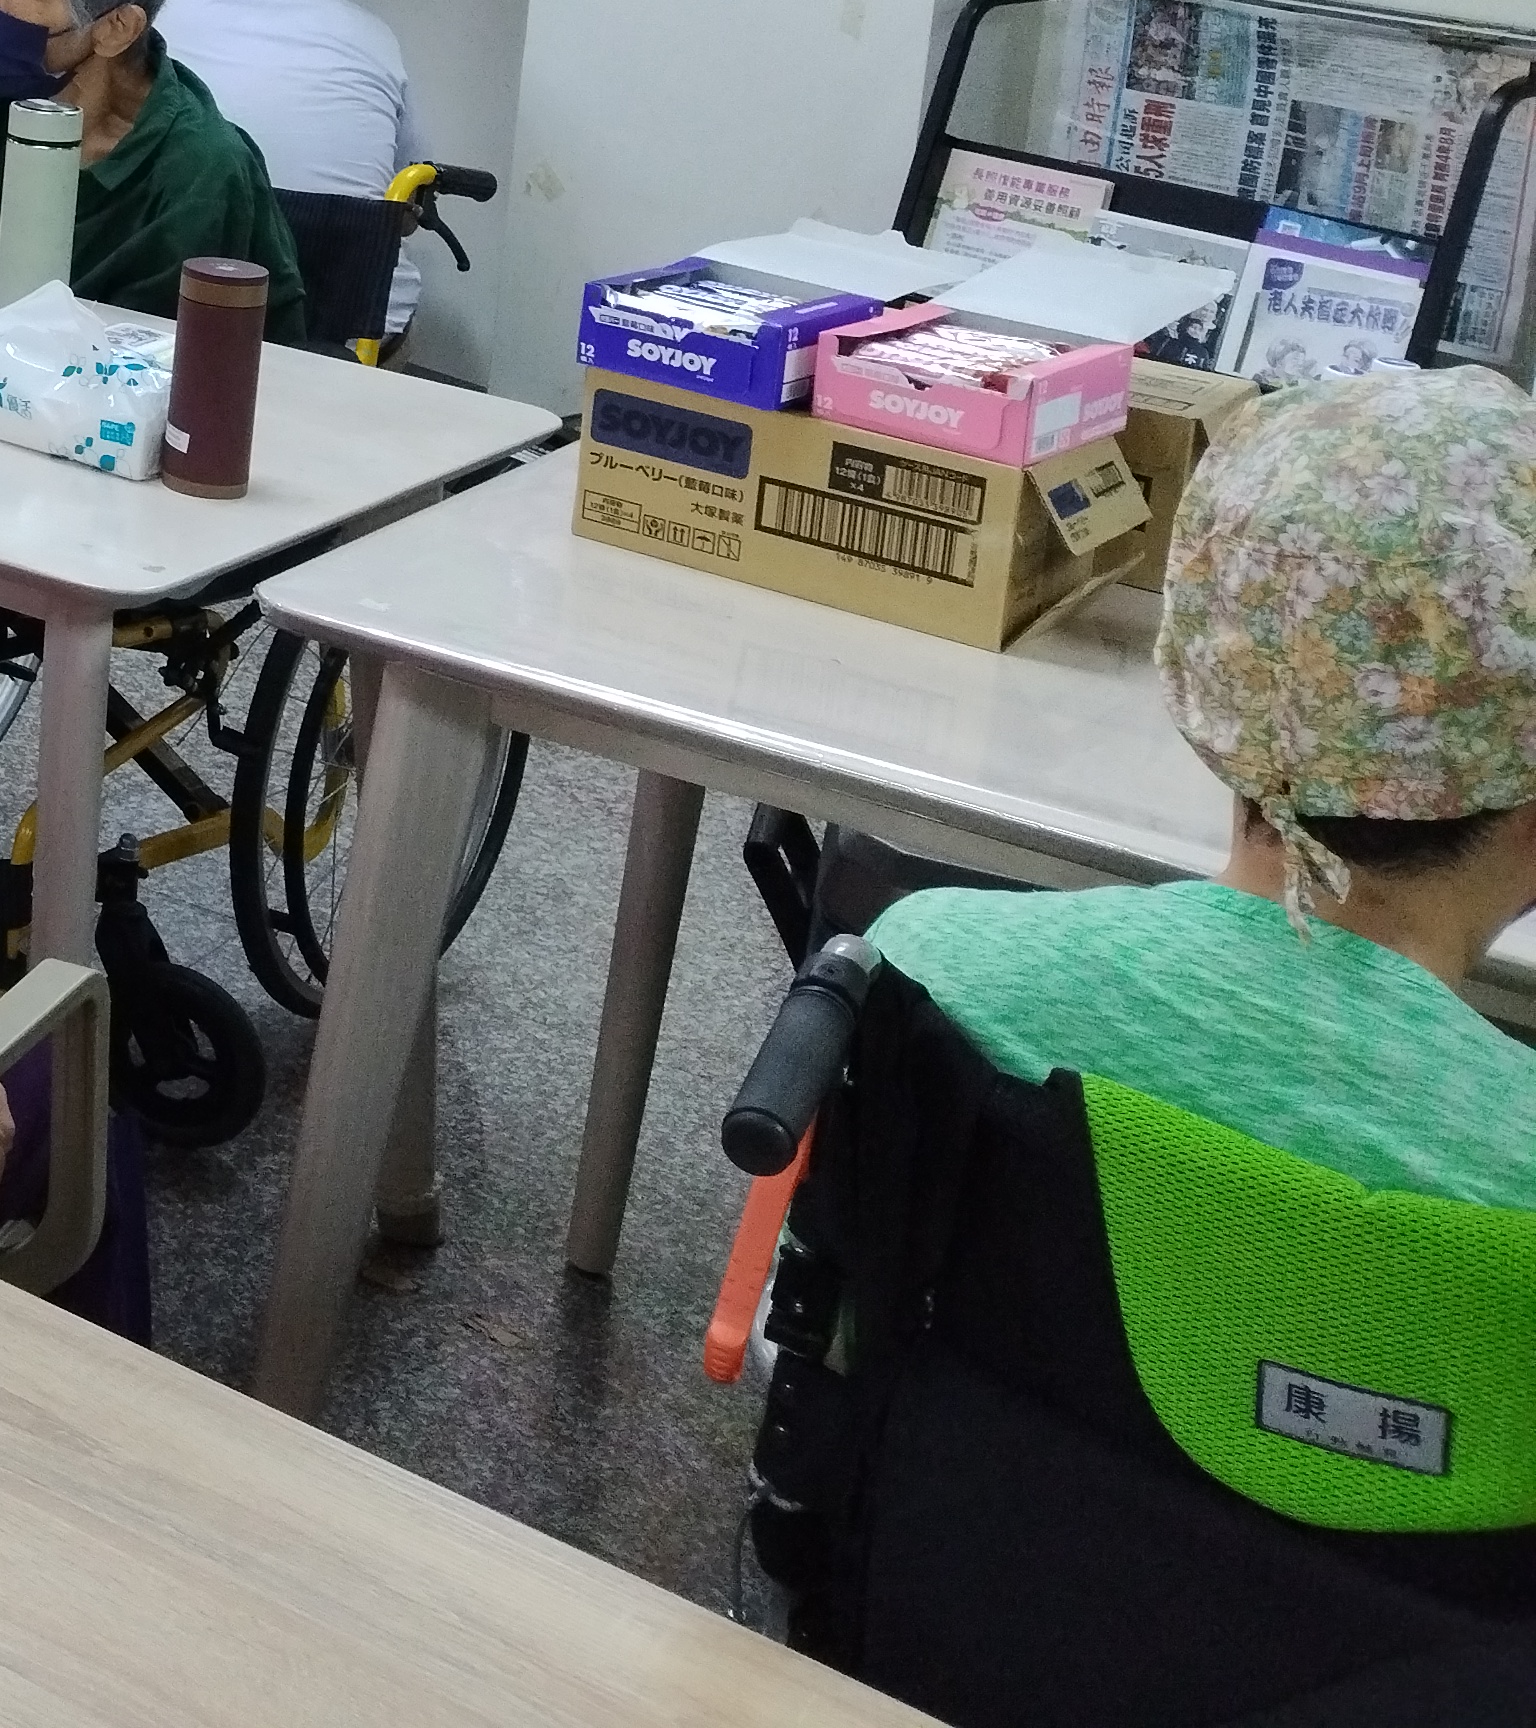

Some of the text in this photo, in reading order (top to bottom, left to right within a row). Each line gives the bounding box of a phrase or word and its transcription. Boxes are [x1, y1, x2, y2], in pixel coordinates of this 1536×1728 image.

[1078, 65, 1116, 168] 由時報
[580, 342, 595, 357] 12
[627, 338, 717, 376] SOYJOY
[816, 395, 834, 410] 12
[868, 389, 966, 429] SOYJOY
[599, 402, 745, 463] SOYJOY
